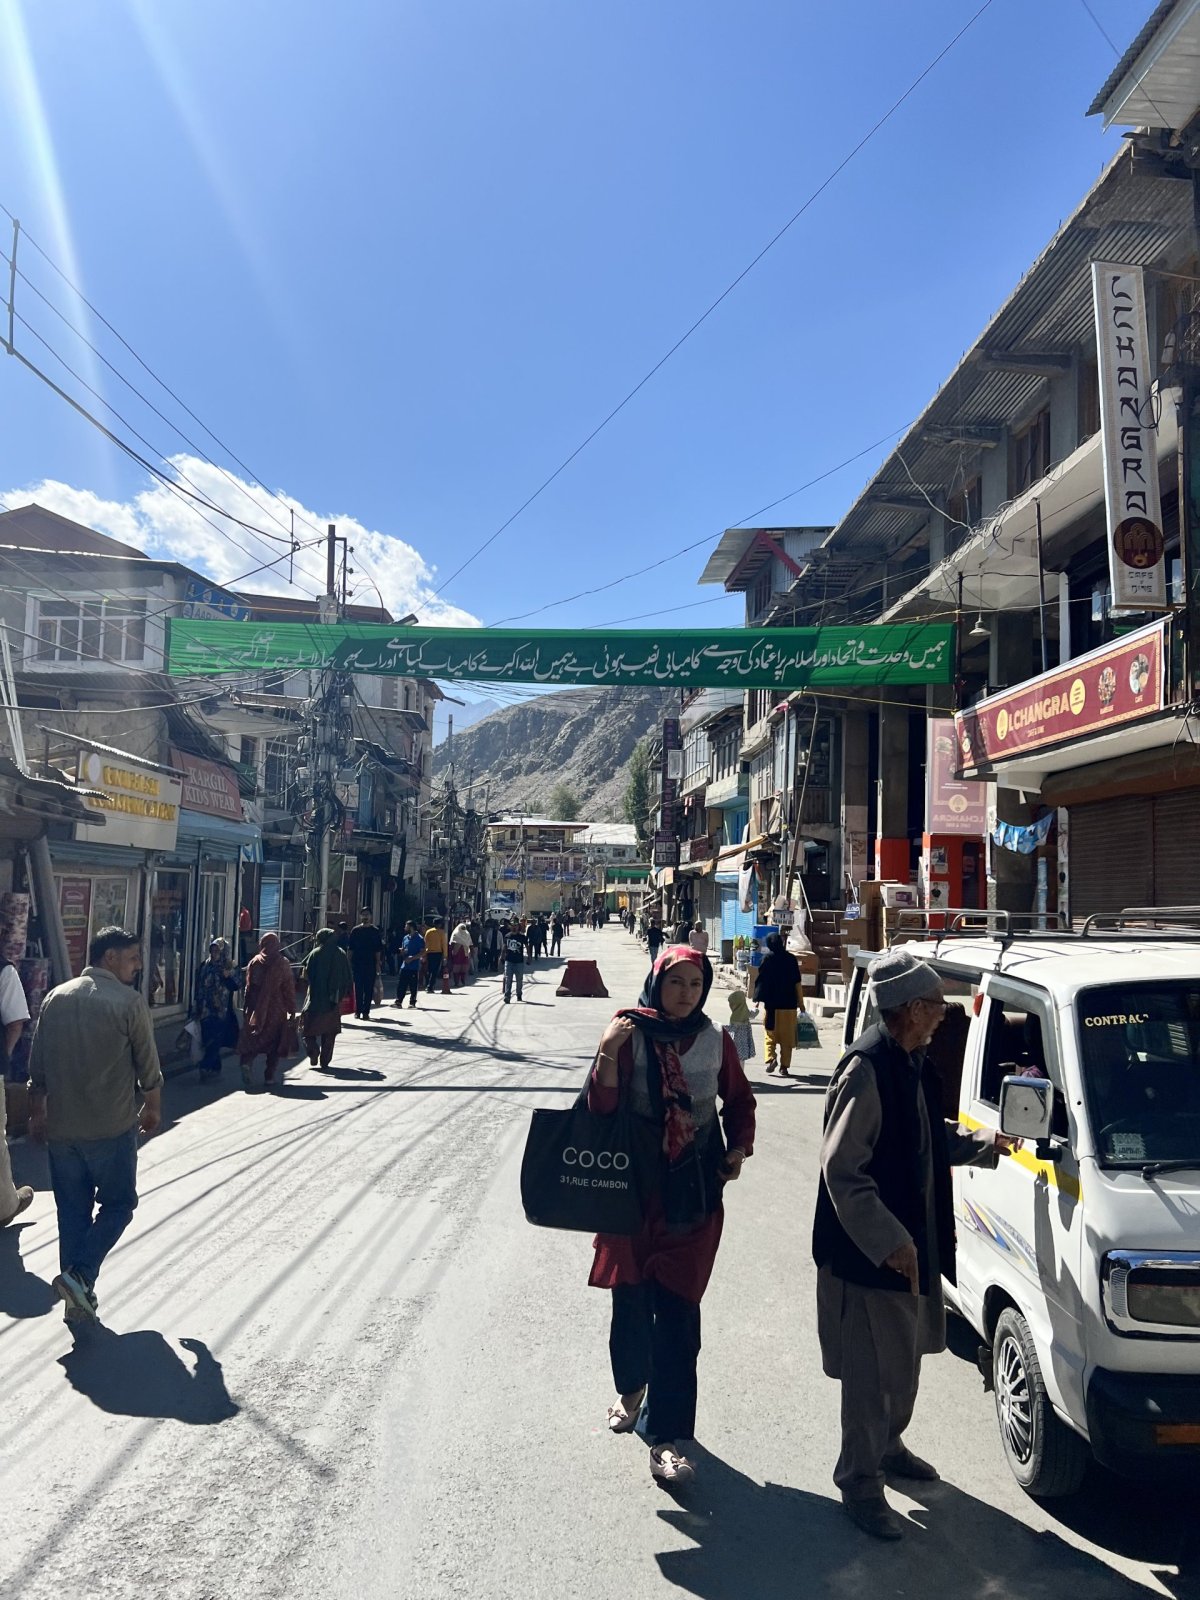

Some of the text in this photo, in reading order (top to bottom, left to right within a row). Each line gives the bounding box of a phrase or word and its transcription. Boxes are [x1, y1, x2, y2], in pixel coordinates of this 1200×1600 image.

[419, 649, 487, 676] کامیاب
[478, 654, 504, 672] نے
[619, 644, 660, 677] نصیب
[654, 645, 706, 679] کامیابی
[702, 644, 747, 657] سے
[736, 637, 765, 675] کی
[753, 644, 782, 670] اعتماد
[830, 639, 856, 667] اتحاد
[909, 640, 947, 669] ہمیں
[716, 655, 738, 676] وجہ
[1007, 692, 1070, 732] LCHANGRA
[189, 767, 228, 793] KARGIL
[184, 785, 235, 811] KIDS WEAR
[562, 1147, 629, 1170] COCO
[591, 1179, 628, 1190] CAMBON
